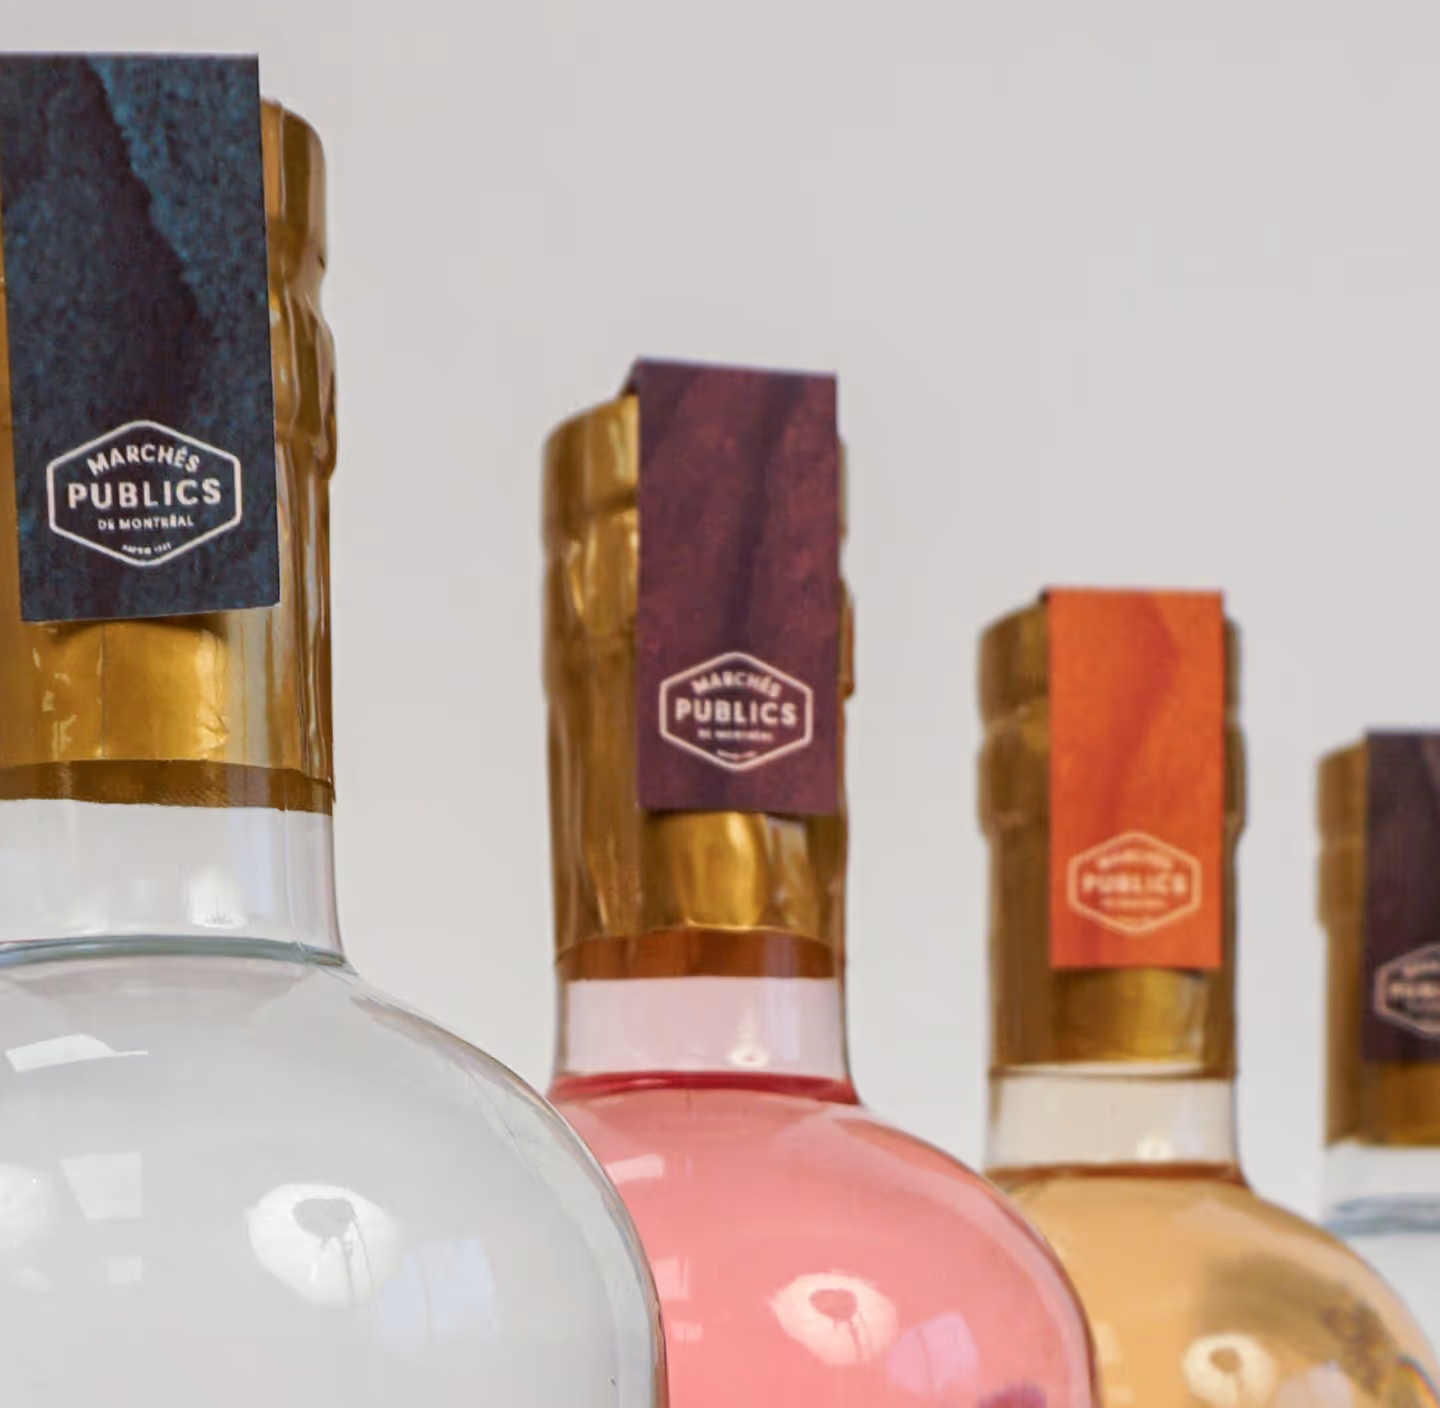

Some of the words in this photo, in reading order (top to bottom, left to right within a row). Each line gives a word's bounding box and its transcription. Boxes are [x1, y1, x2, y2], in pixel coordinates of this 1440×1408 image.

[87, 443, 200, 477] MARCHÉS
[67, 478, 222, 510] PUBLICS
[98, 519, 115, 532] DE
[674, 697, 797, 726] PUBLICS
